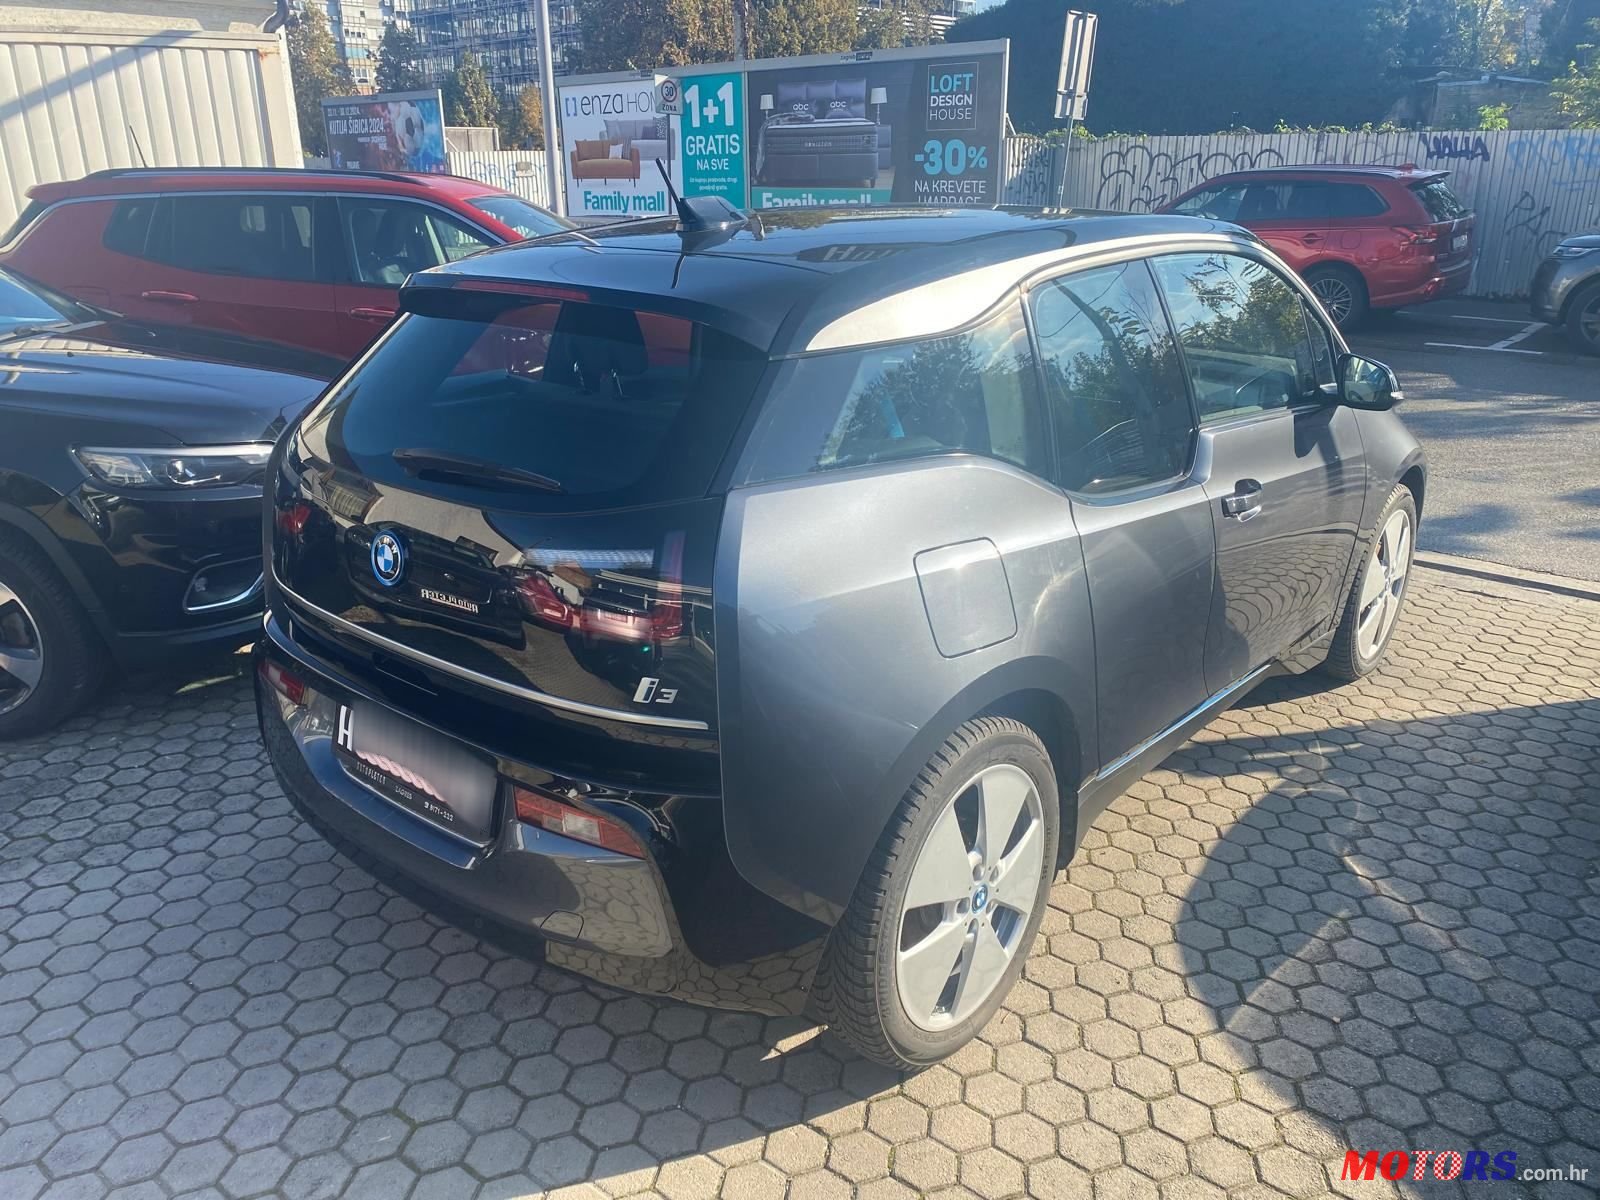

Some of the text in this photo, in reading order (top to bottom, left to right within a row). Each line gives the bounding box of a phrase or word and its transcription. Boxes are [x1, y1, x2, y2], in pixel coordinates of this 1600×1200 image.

[930, 73, 974, 93] LOFT
[665, 86, 674, 97] 30
[580, 93, 624, 115] enza
[662, 103, 677, 112] ZONA
[684, 82, 734, 128] 1+1
[793, 103, 809, 111] abc
[830, 100, 847, 109] abc
[930, 94, 973, 107] DESIGN
[929, 108, 972, 120] HOUSE
[348, 116, 369, 134] ŠIBICA
[369, 117, 386, 133] 2024.
[686, 133, 740, 156] GRATIS
[696, 158, 729, 171] NA SVE
[914, 139, 988, 176] -30%
[914, 180, 987, 194] NA KREVETE
[584, 190, 665, 213] Family mall
[633, 677, 678, 704] i3
